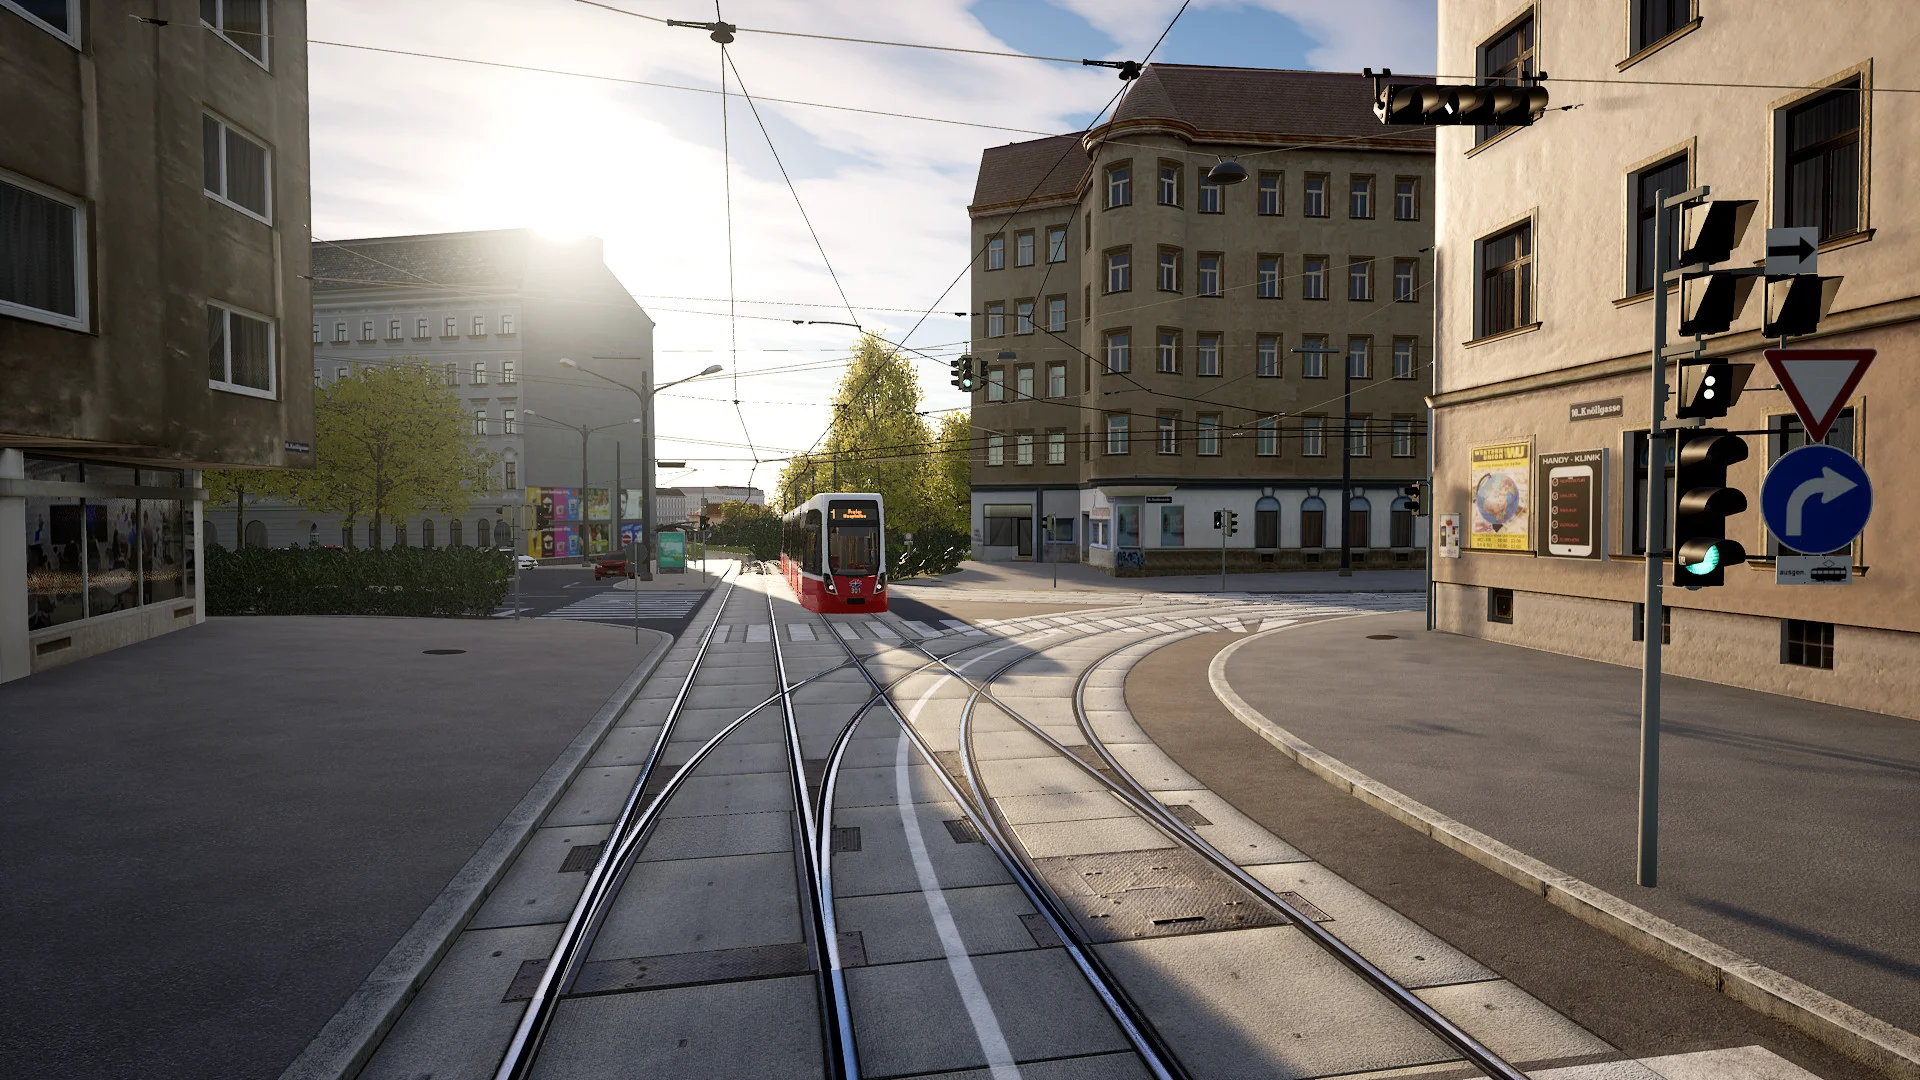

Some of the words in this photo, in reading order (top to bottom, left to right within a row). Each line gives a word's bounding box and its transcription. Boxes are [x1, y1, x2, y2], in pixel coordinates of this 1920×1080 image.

[1581, 405, 1621, 416] Knöllgasse
[1475, 447, 1504, 456] WESTERN
[1483, 453, 1504, 461] UNION
[1542, 456, 1570, 465] HANDY
[1574, 453, 1601, 463] KLINIK
[830, 508, 836, 520] 1
